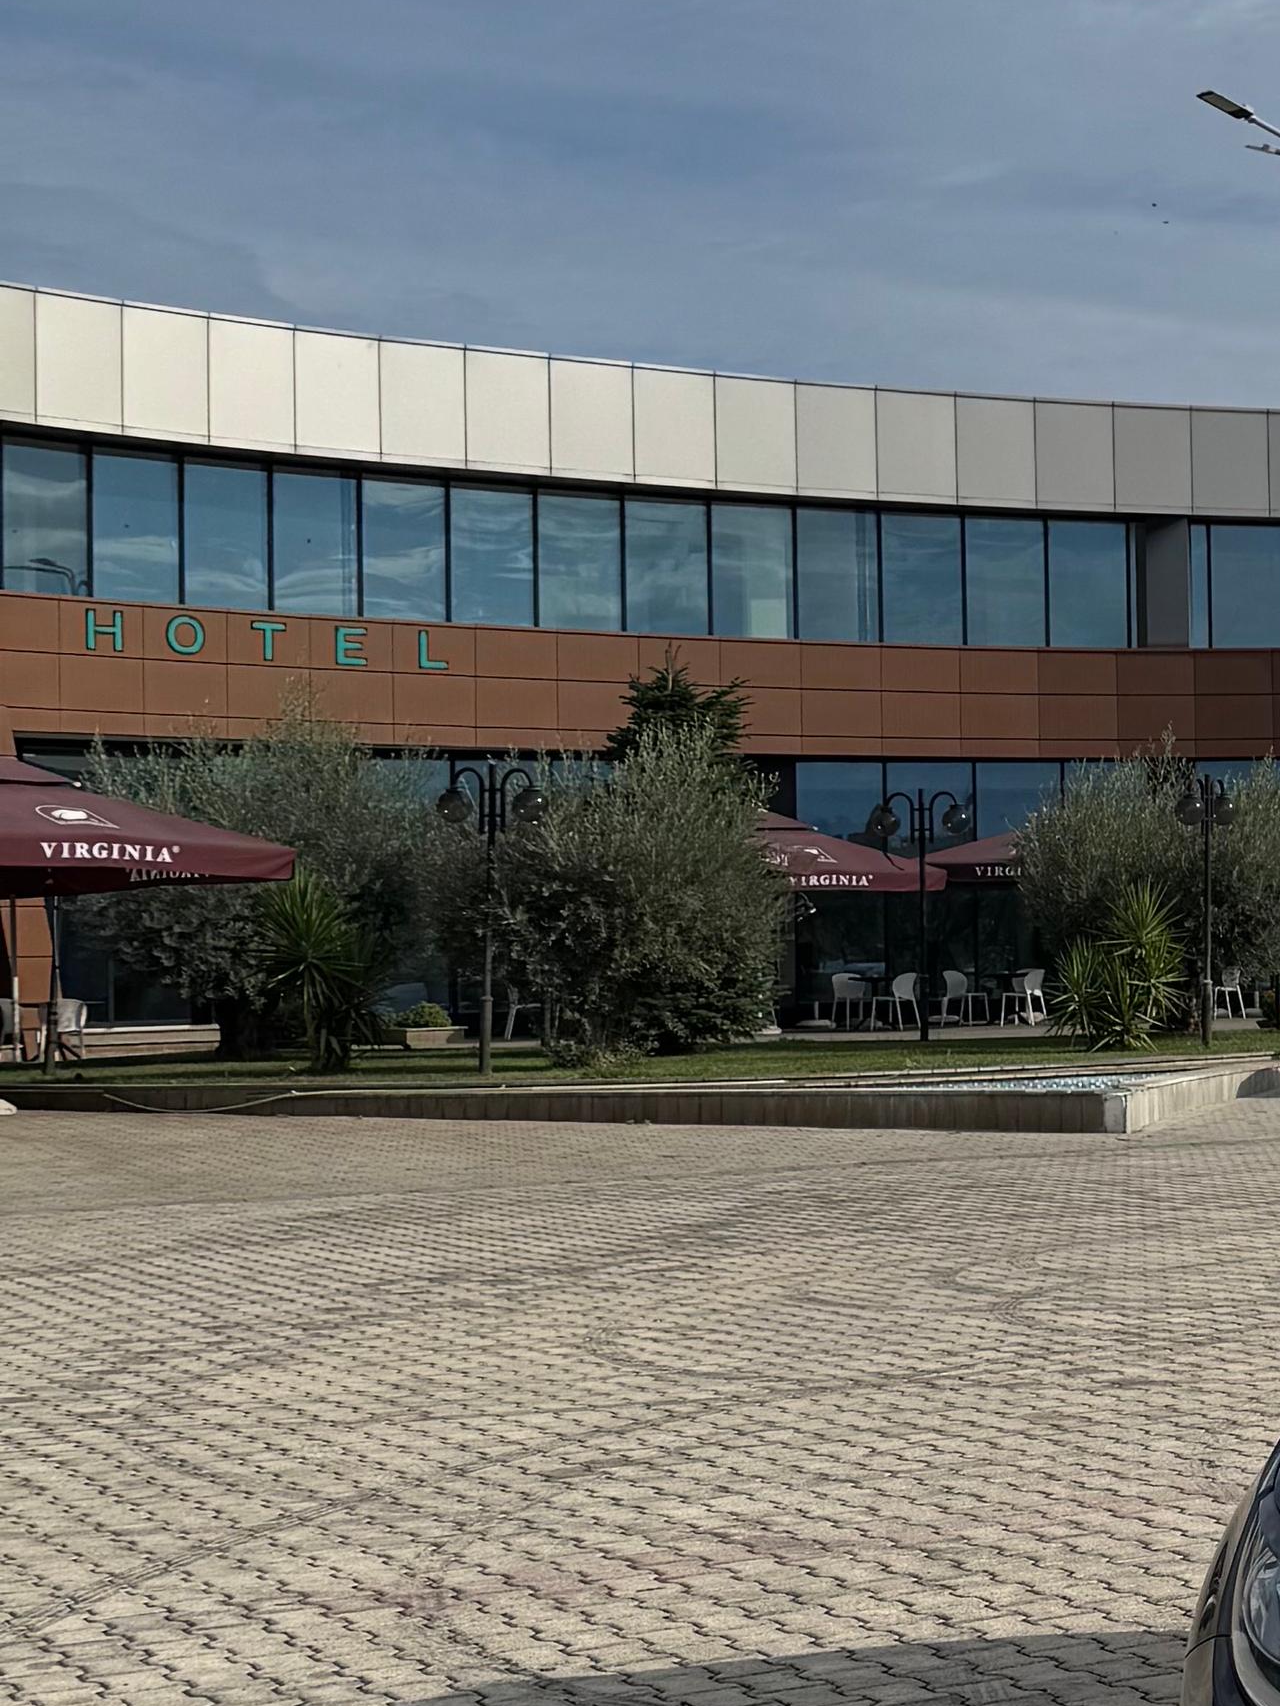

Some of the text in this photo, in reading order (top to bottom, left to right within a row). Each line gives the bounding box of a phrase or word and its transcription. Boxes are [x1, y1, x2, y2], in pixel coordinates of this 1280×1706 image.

[85, 608, 449, 670] HOTEL
[40, 842, 174, 863] VIRGINIA
[975, 865, 1022, 877] VIRGI
